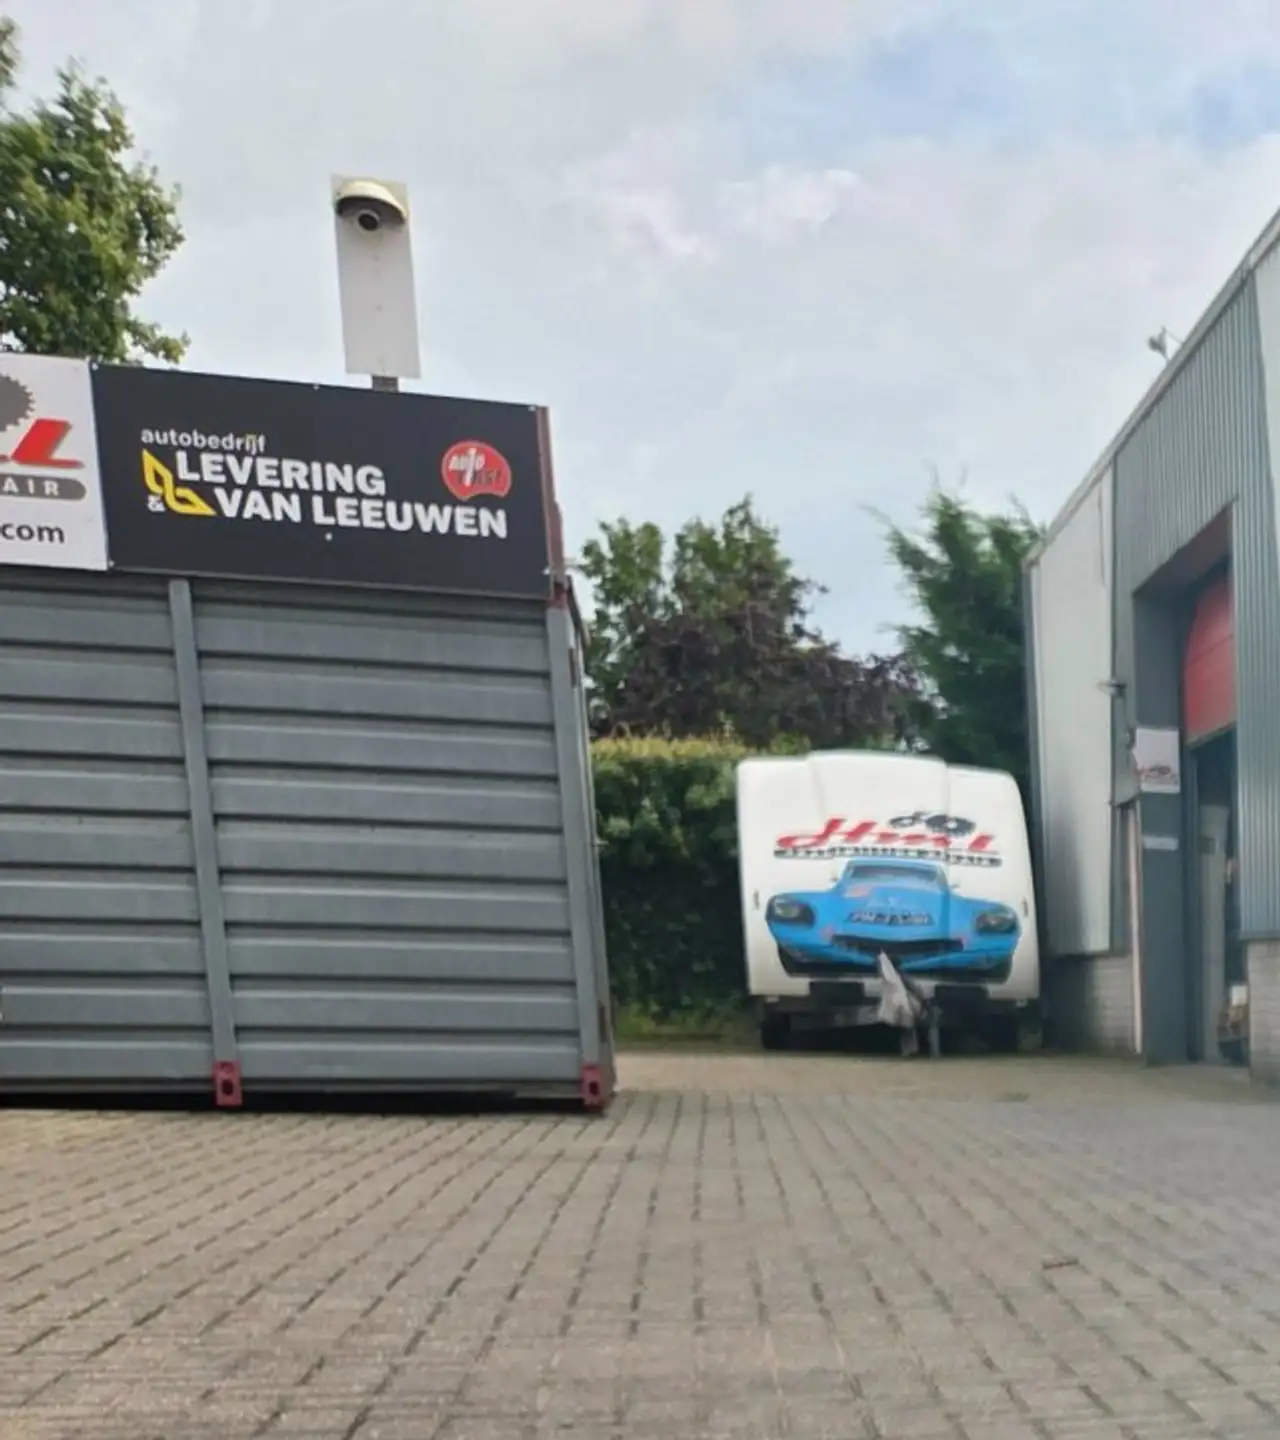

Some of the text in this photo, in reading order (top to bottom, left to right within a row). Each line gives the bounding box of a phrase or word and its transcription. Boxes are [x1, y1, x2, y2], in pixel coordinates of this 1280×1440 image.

[141, 428, 267, 455] autobedrijf
[175, 449, 387, 497] LEVERING
[213, 486, 302, 523] VAN
[311, 494, 508, 540] LEEUWEN
